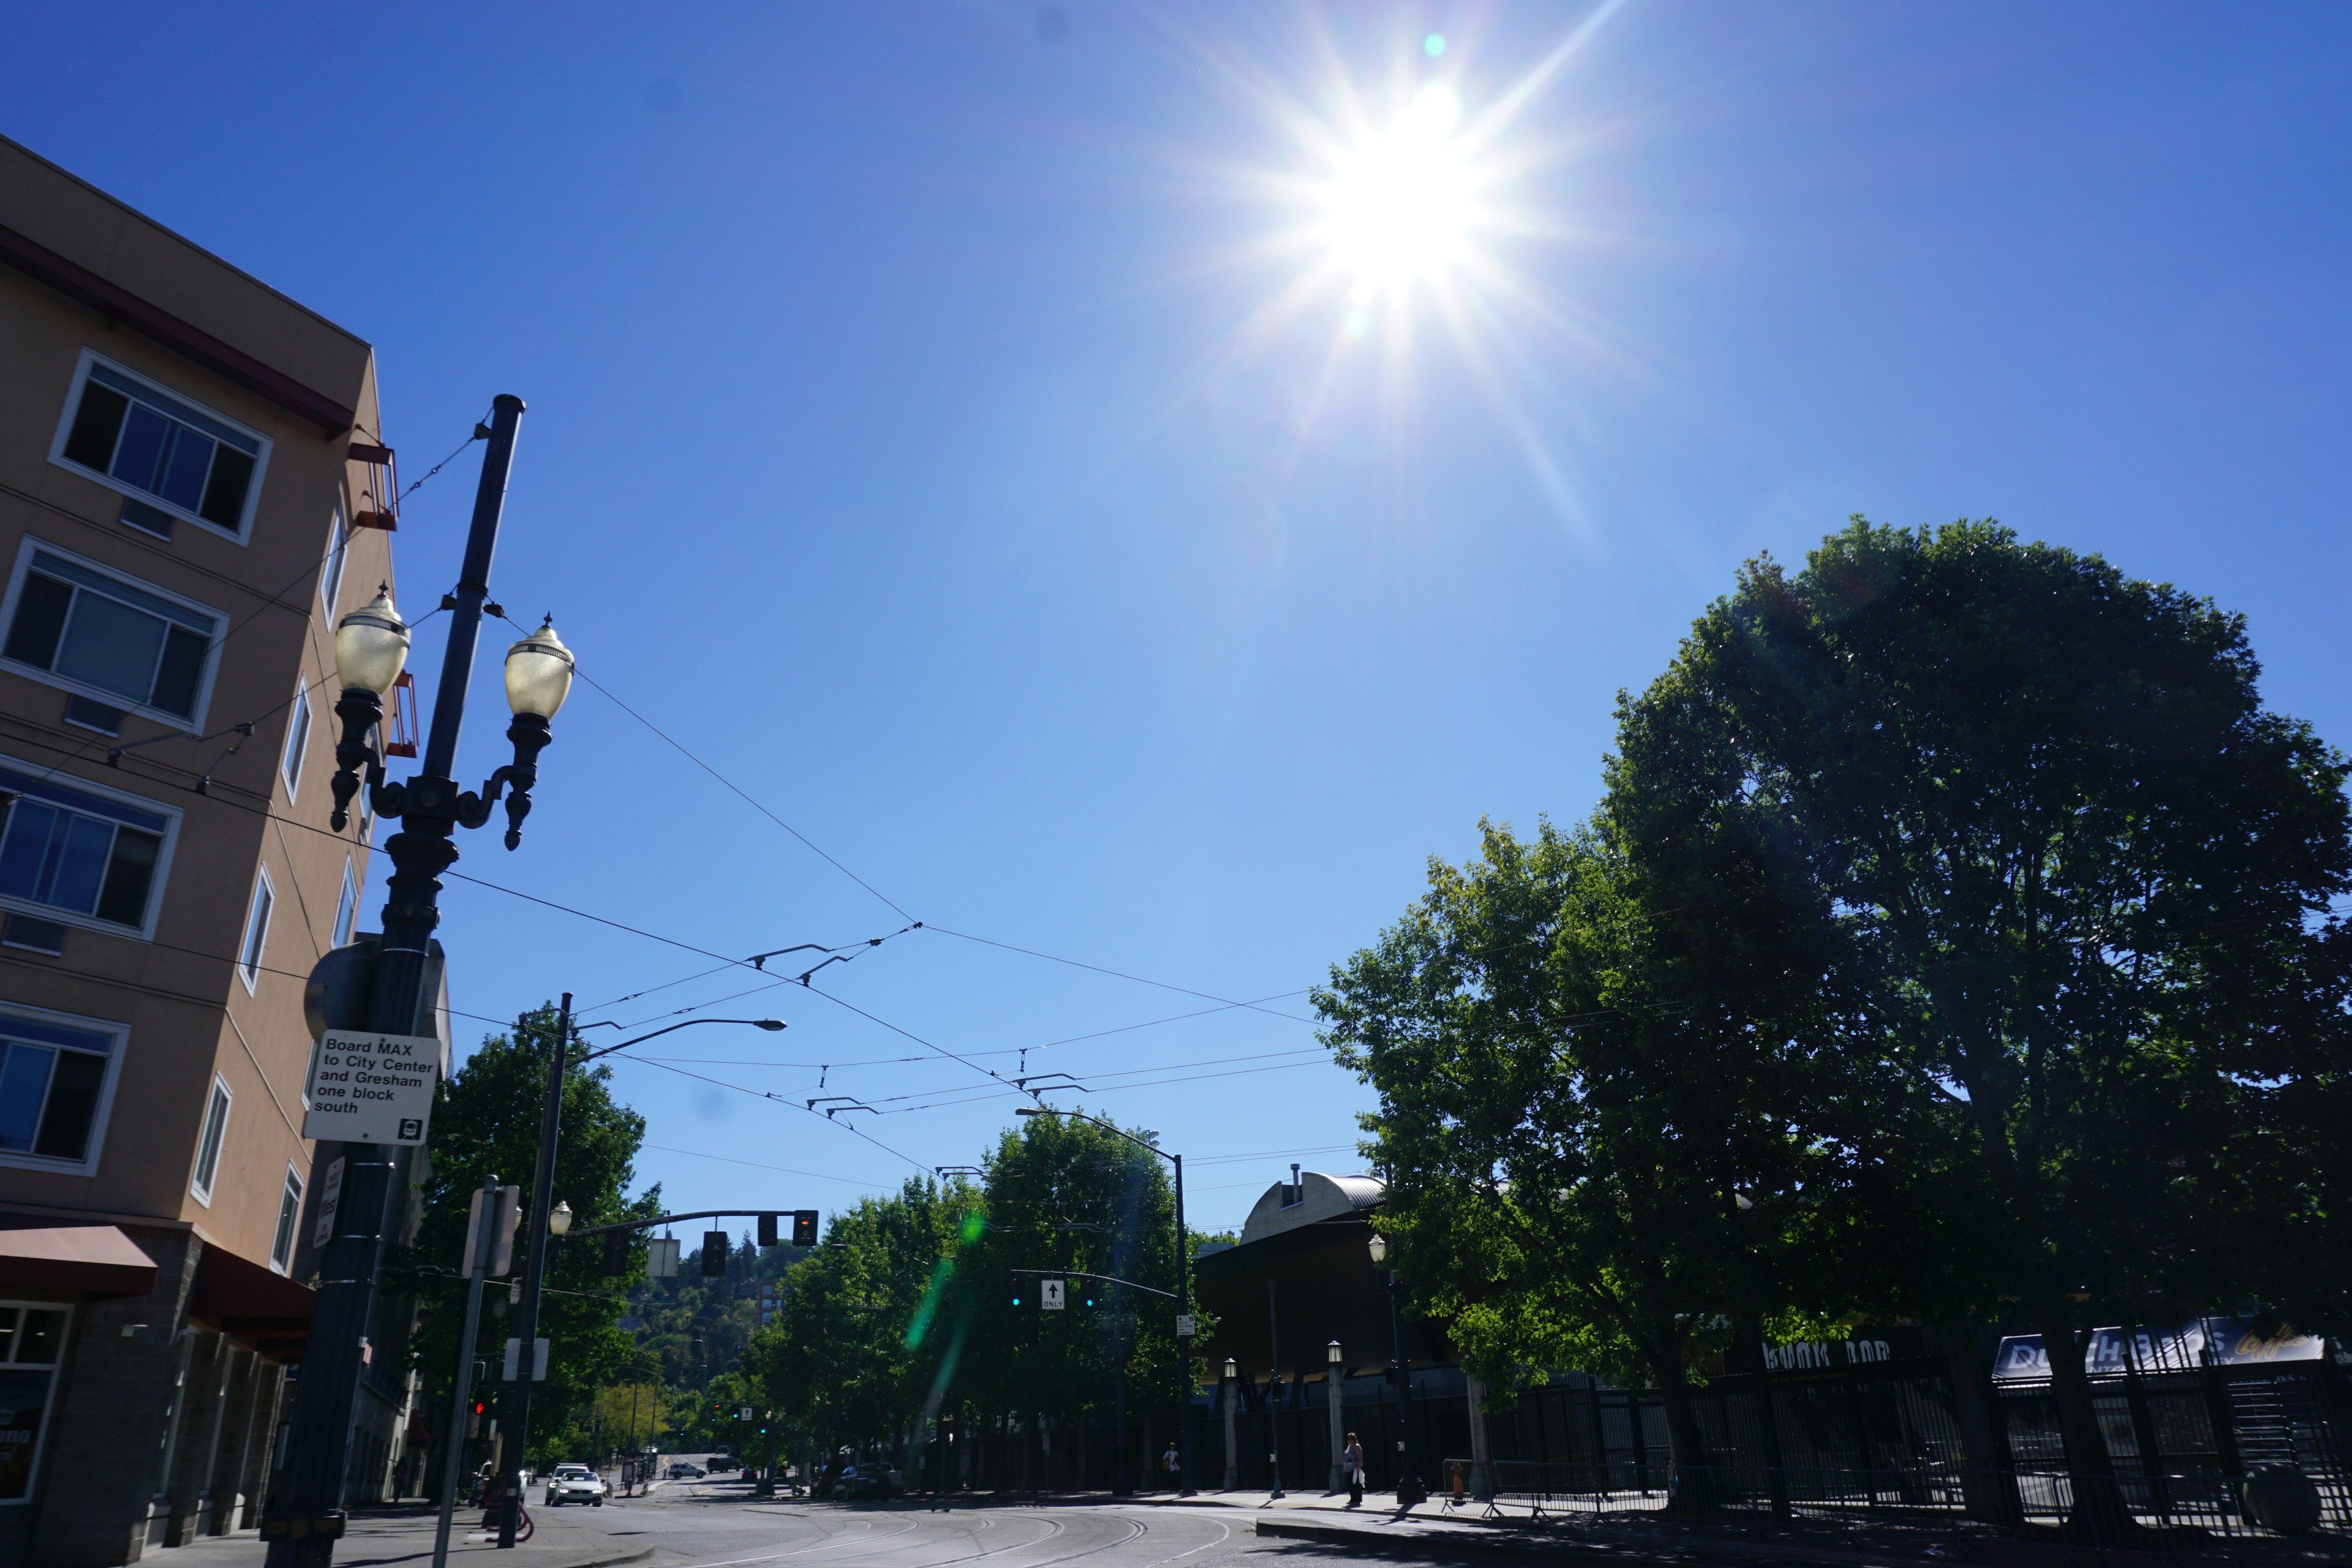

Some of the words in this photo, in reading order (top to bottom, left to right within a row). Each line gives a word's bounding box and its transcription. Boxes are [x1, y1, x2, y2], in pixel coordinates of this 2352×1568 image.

[326, 1039, 371, 1053] Board
[377, 1042, 412, 1056] MAX
[324, 1054, 339, 1065] to
[346, 1055, 377, 1070] City
[383, 1058, 433, 1073] Center
[320, 1071, 349, 1082] and
[355, 1072, 422, 1087] Gresham
[318, 1087, 345, 1097] one
[353, 1087, 394, 1101] block
[314, 1102, 358, 1114] south
